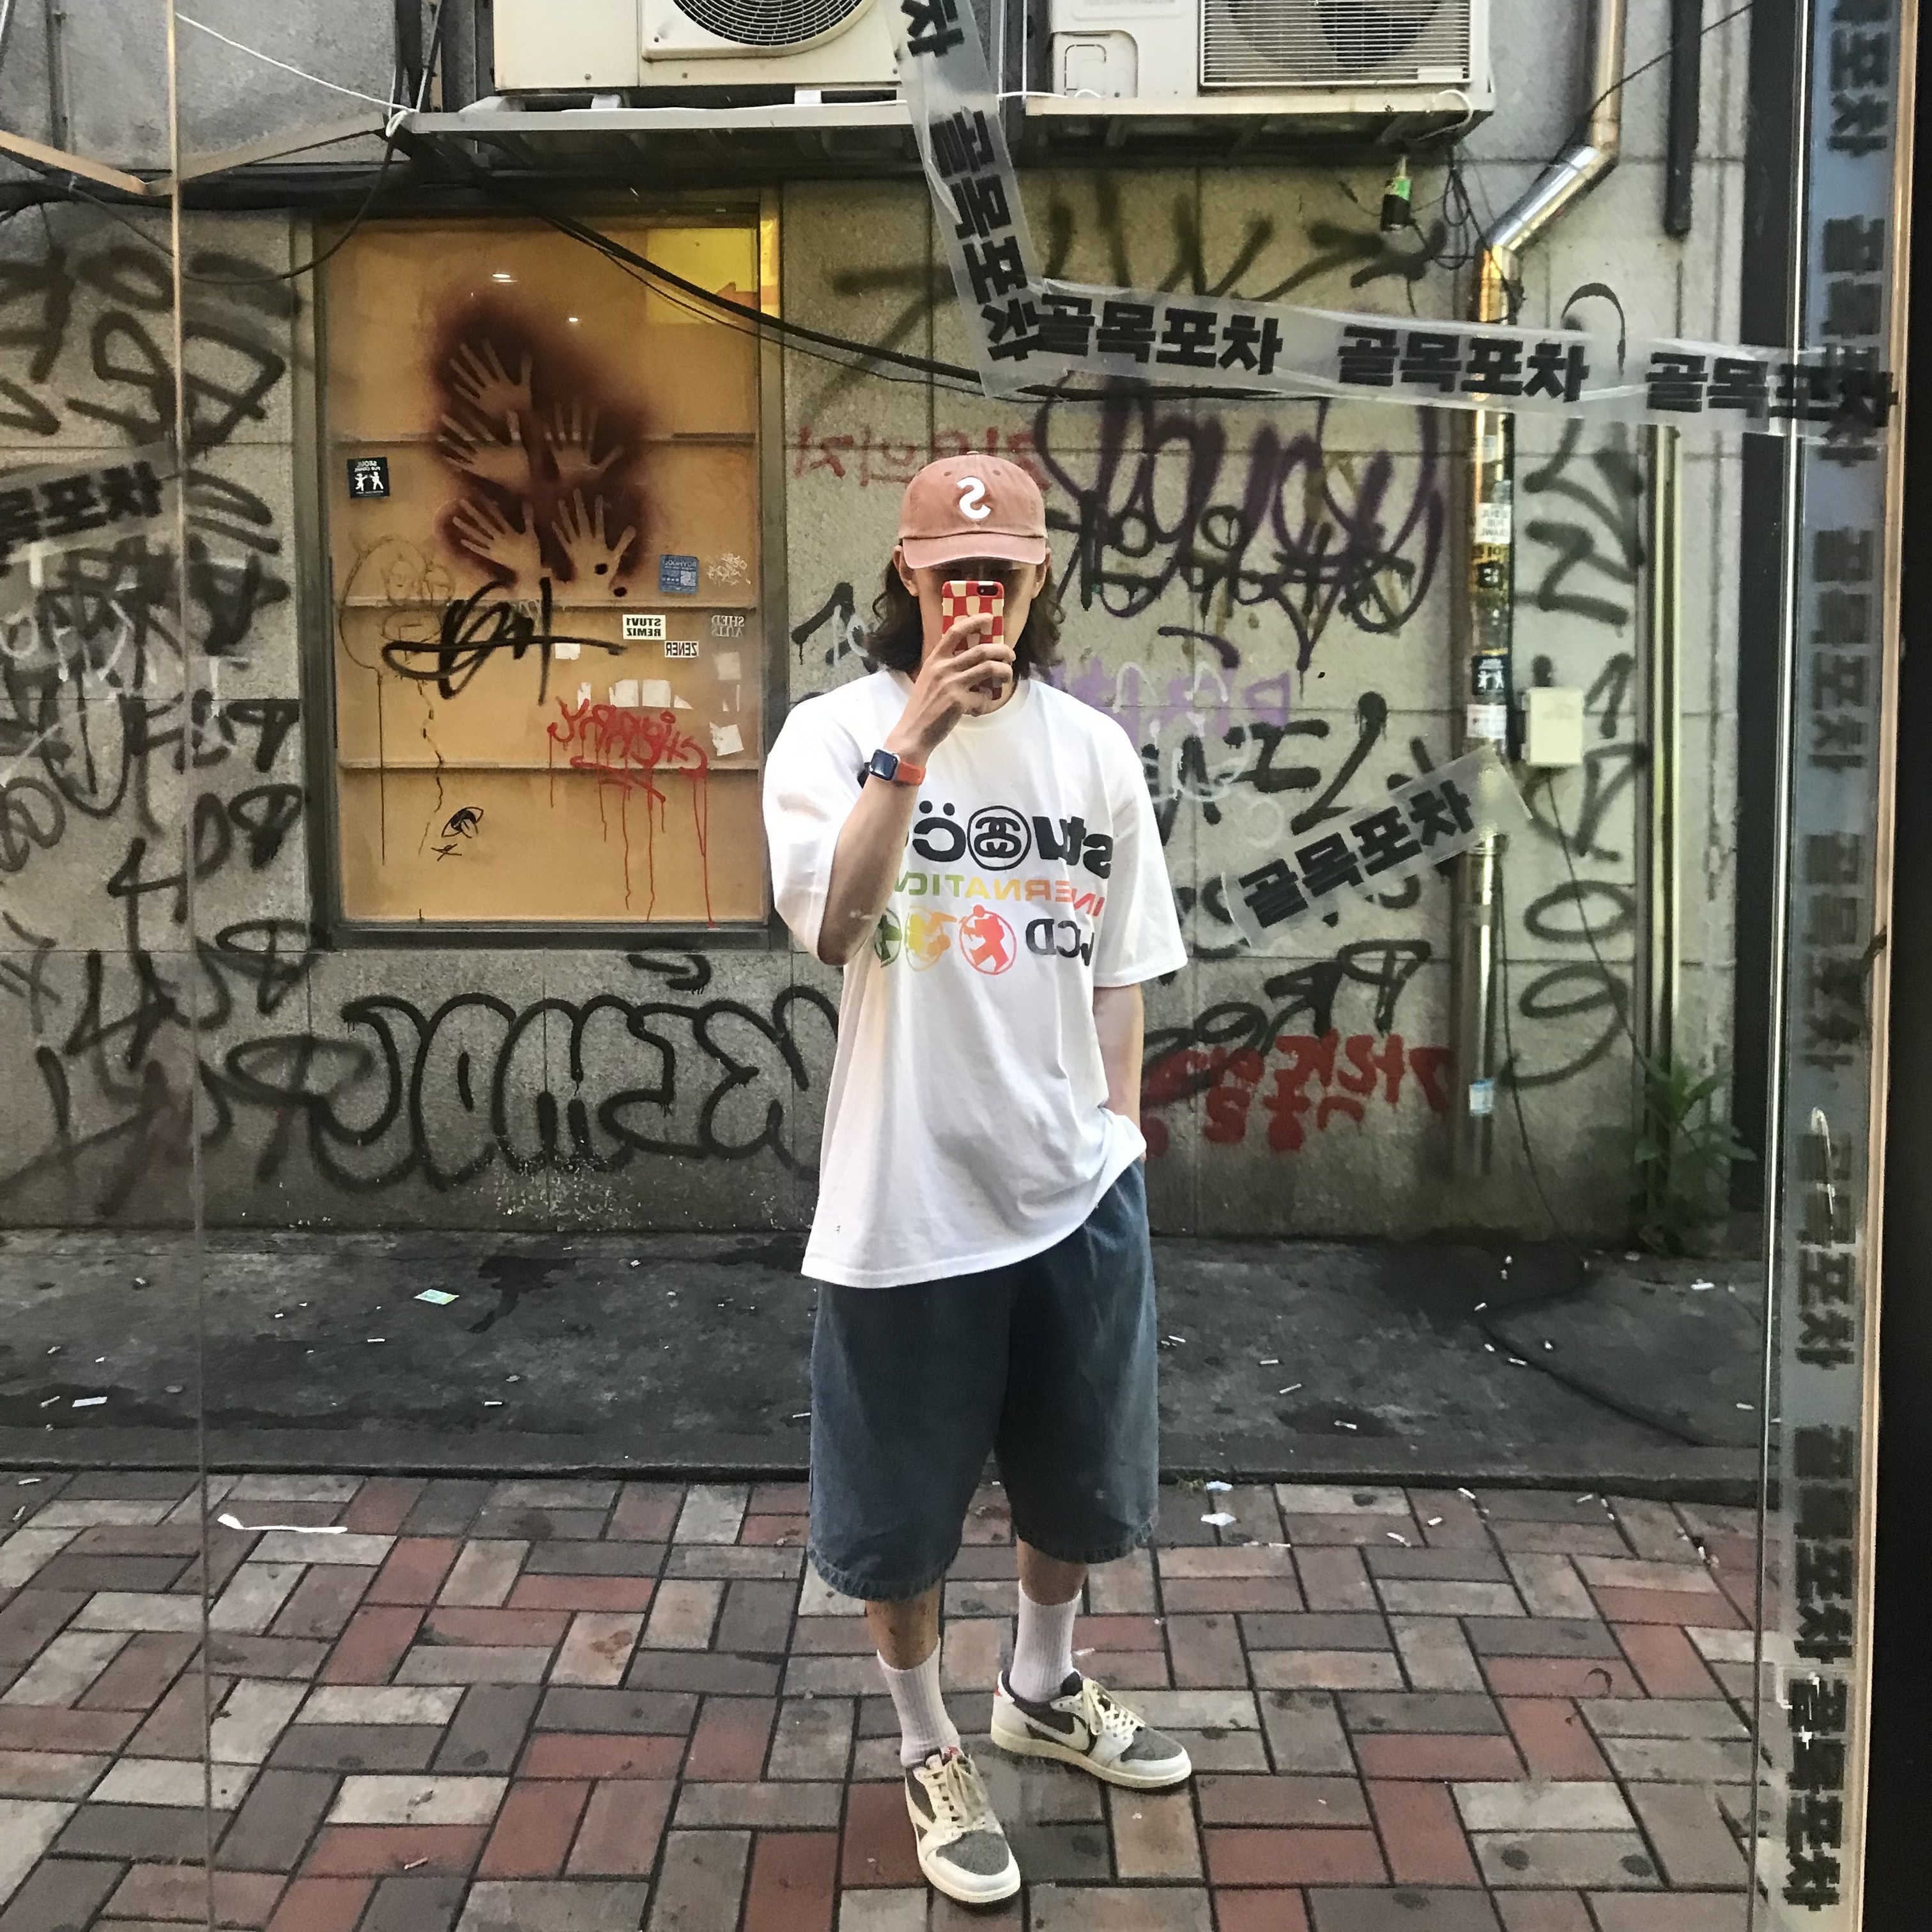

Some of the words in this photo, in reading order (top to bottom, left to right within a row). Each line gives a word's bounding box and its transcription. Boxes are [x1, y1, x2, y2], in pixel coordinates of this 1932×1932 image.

[929, 105, 1043, 363] 골목포차
[1034, 291, 1284, 377] 골목포차
[1338, 323, 1591, 404] 골목포차
[1644, 351, 1899, 428] 골목포차
[1238, 779, 1475, 928] 골목포차
